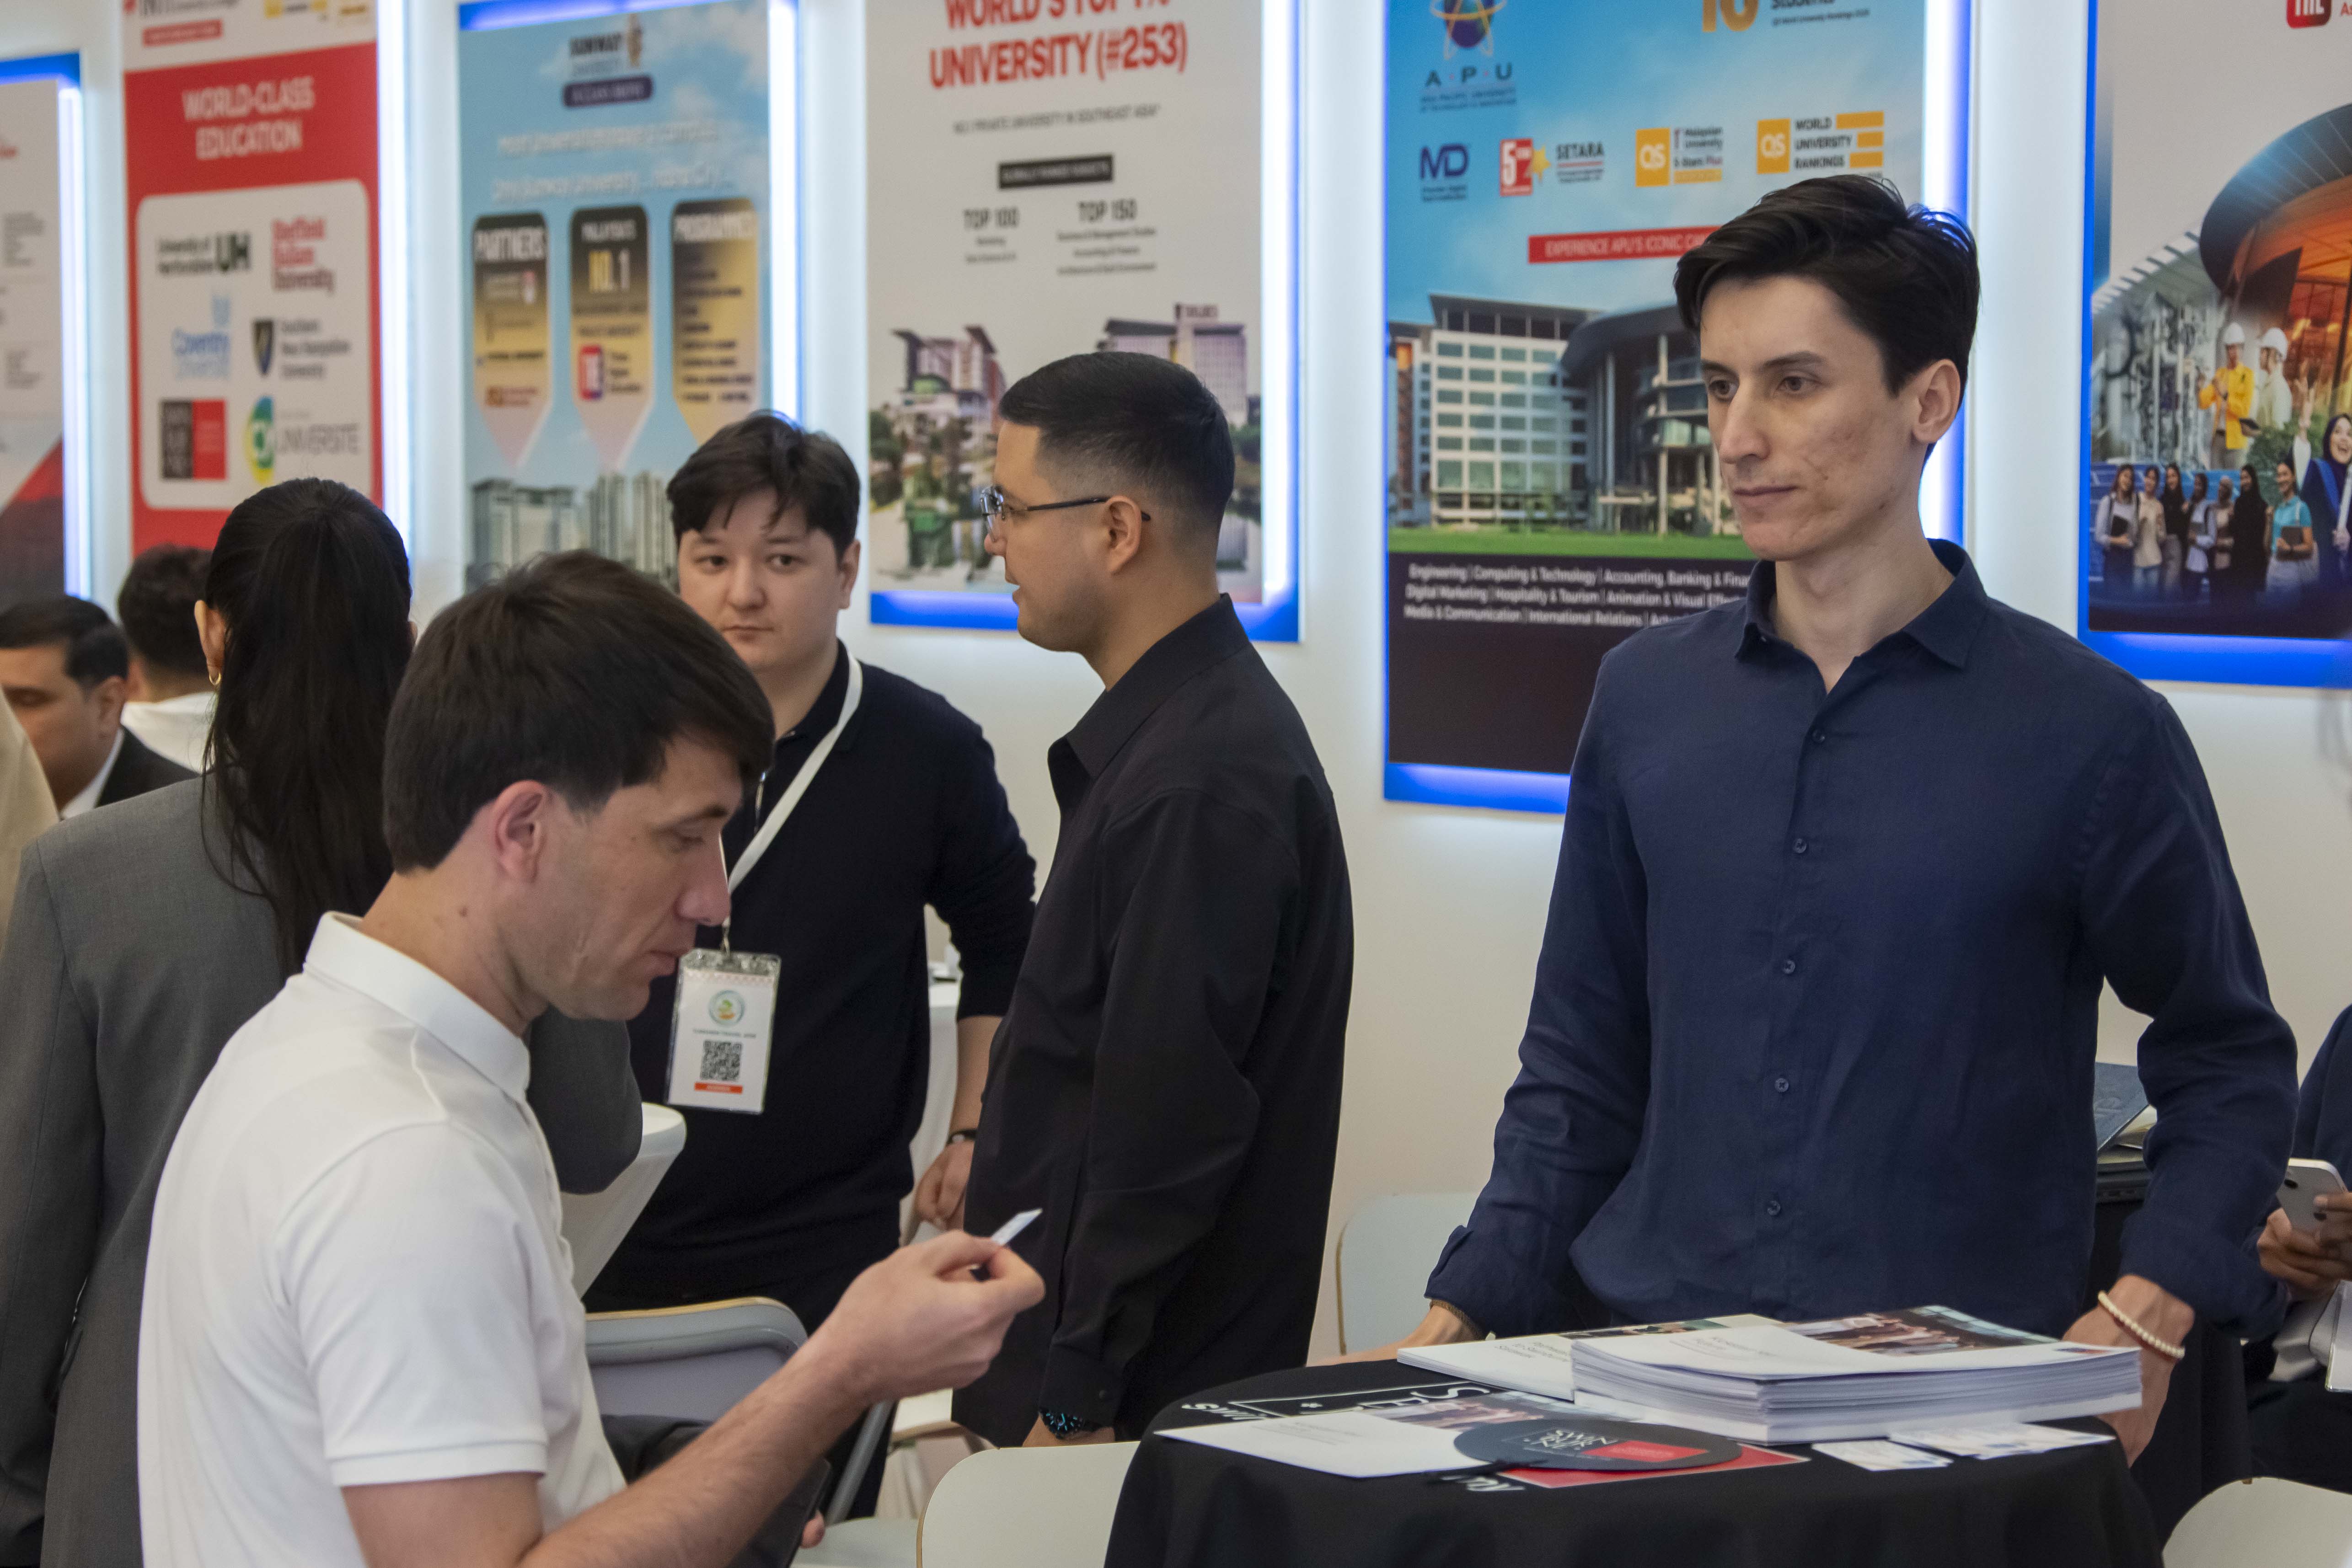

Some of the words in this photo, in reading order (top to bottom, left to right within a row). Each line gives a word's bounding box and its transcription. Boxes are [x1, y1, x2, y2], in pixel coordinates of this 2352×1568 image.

[929, 31, 1092, 88] UNIVERSITY
[1098, 21, 1188, 80] (#253)
[184, 77, 316, 121] WORLD-CLASS
[1795, 117, 1832, 131] WORLD
[195, 120, 303, 160] EDUCATION
[1557, 141, 1605, 160] SETARA
[1761, 134, 1787, 159] QS
[1794, 134, 1852, 151] UNIVERSITY
[1639, 143, 1668, 171] QS
[1794, 154, 1845, 170] RANKINGS
[964, 207, 990, 229] TOP
[1077, 199, 1108, 224] TOP
[1111, 198, 1138, 221] 150
[1409, 562, 1467, 583] Engineering
[1473, 564, 1530, 585] Computing
[1539, 567, 1596, 587] Technology
[1667, 570, 1712, 590] Banking
[1405, 582, 1436, 603] Digital
[1440, 583, 1487, 605] Marketing
[1496, 585, 1548, 607] Hospitality
[1558, 588, 1599, 605] Tourism
[1607, 589, 1661, 607] Animation
[1672, 592, 1705, 609] Visual
[1444, 605, 1520, 622] Communication
[1529, 609, 1591, 626] International
[1595, 610, 1644, 627] Relations
